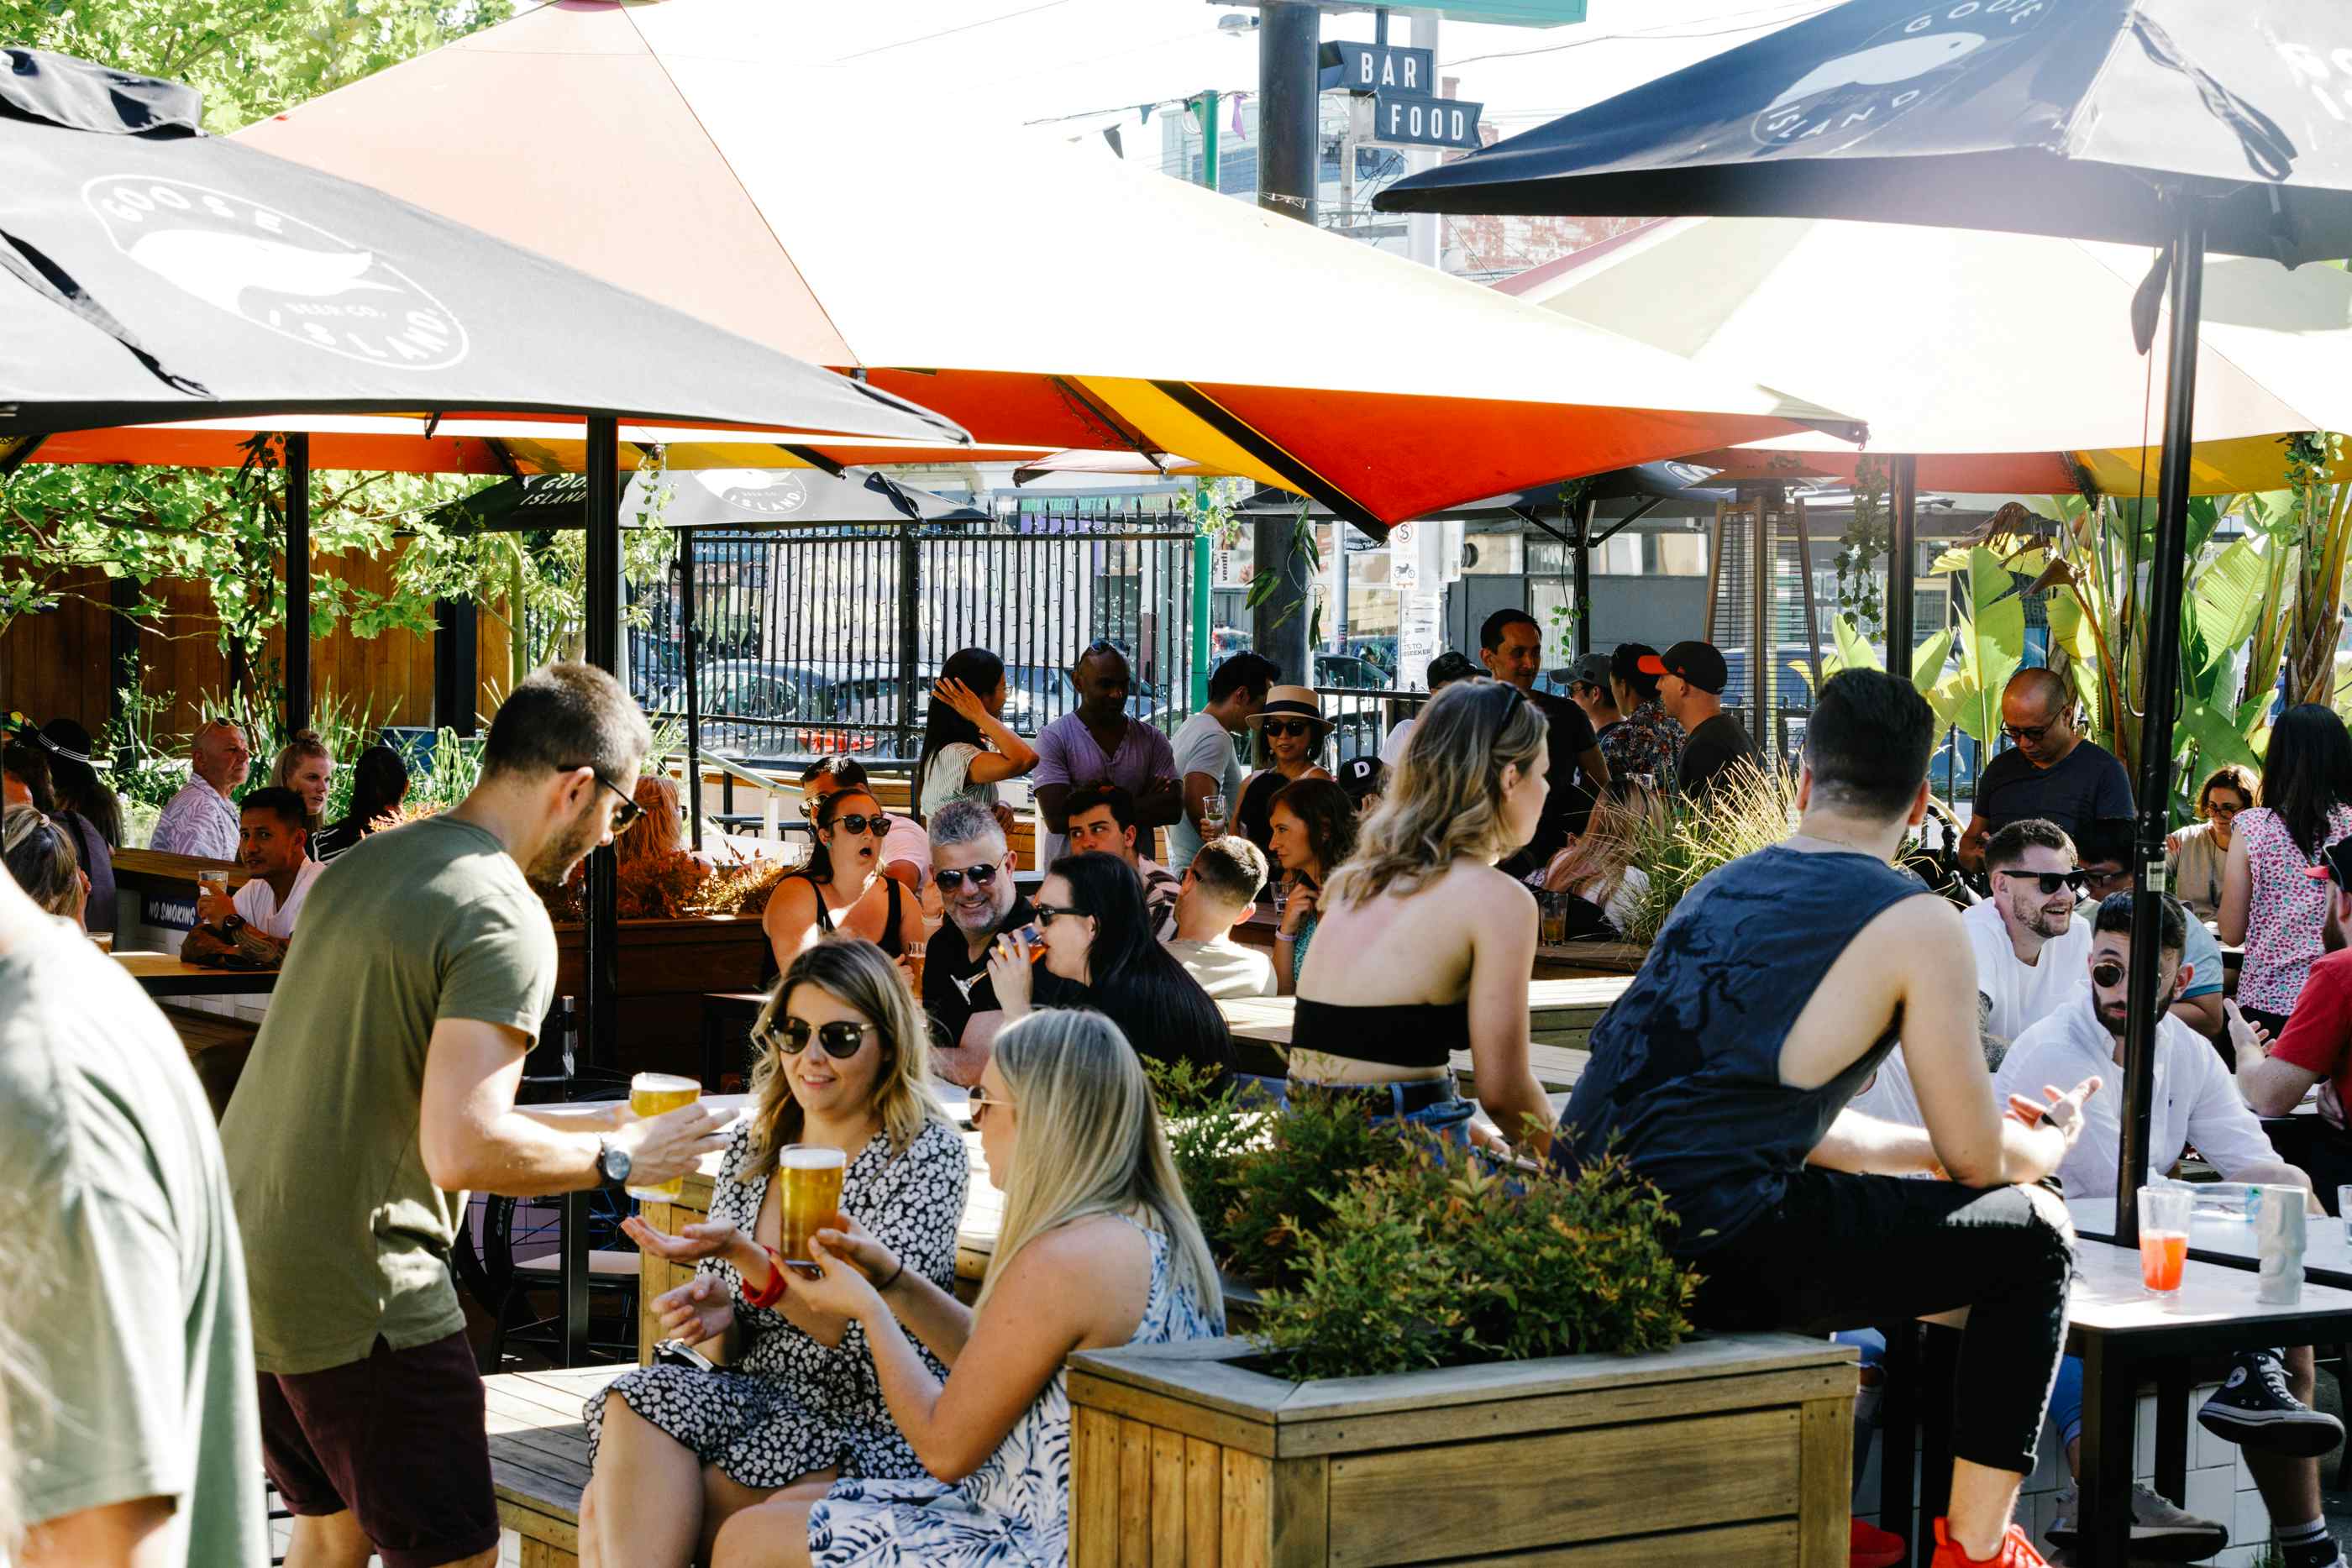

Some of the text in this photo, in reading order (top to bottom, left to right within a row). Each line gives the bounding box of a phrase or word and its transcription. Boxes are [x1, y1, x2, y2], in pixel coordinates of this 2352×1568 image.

[1361, 52, 1417, 88] BAR
[1391, 104, 1464, 141] FOOD
[1767, 90, 1920, 139] ISLAND
[101, 185, 283, 233] GOOSE
[268, 309, 449, 361] ISLAND
[519, 491, 587, 506] ISLAND
[730, 492, 801, 511] ISLAND
[1099, 496, 1122, 511] SOP
[1353, 761, 1371, 779] D
[149, 900, 196, 926] NO SMOKING
